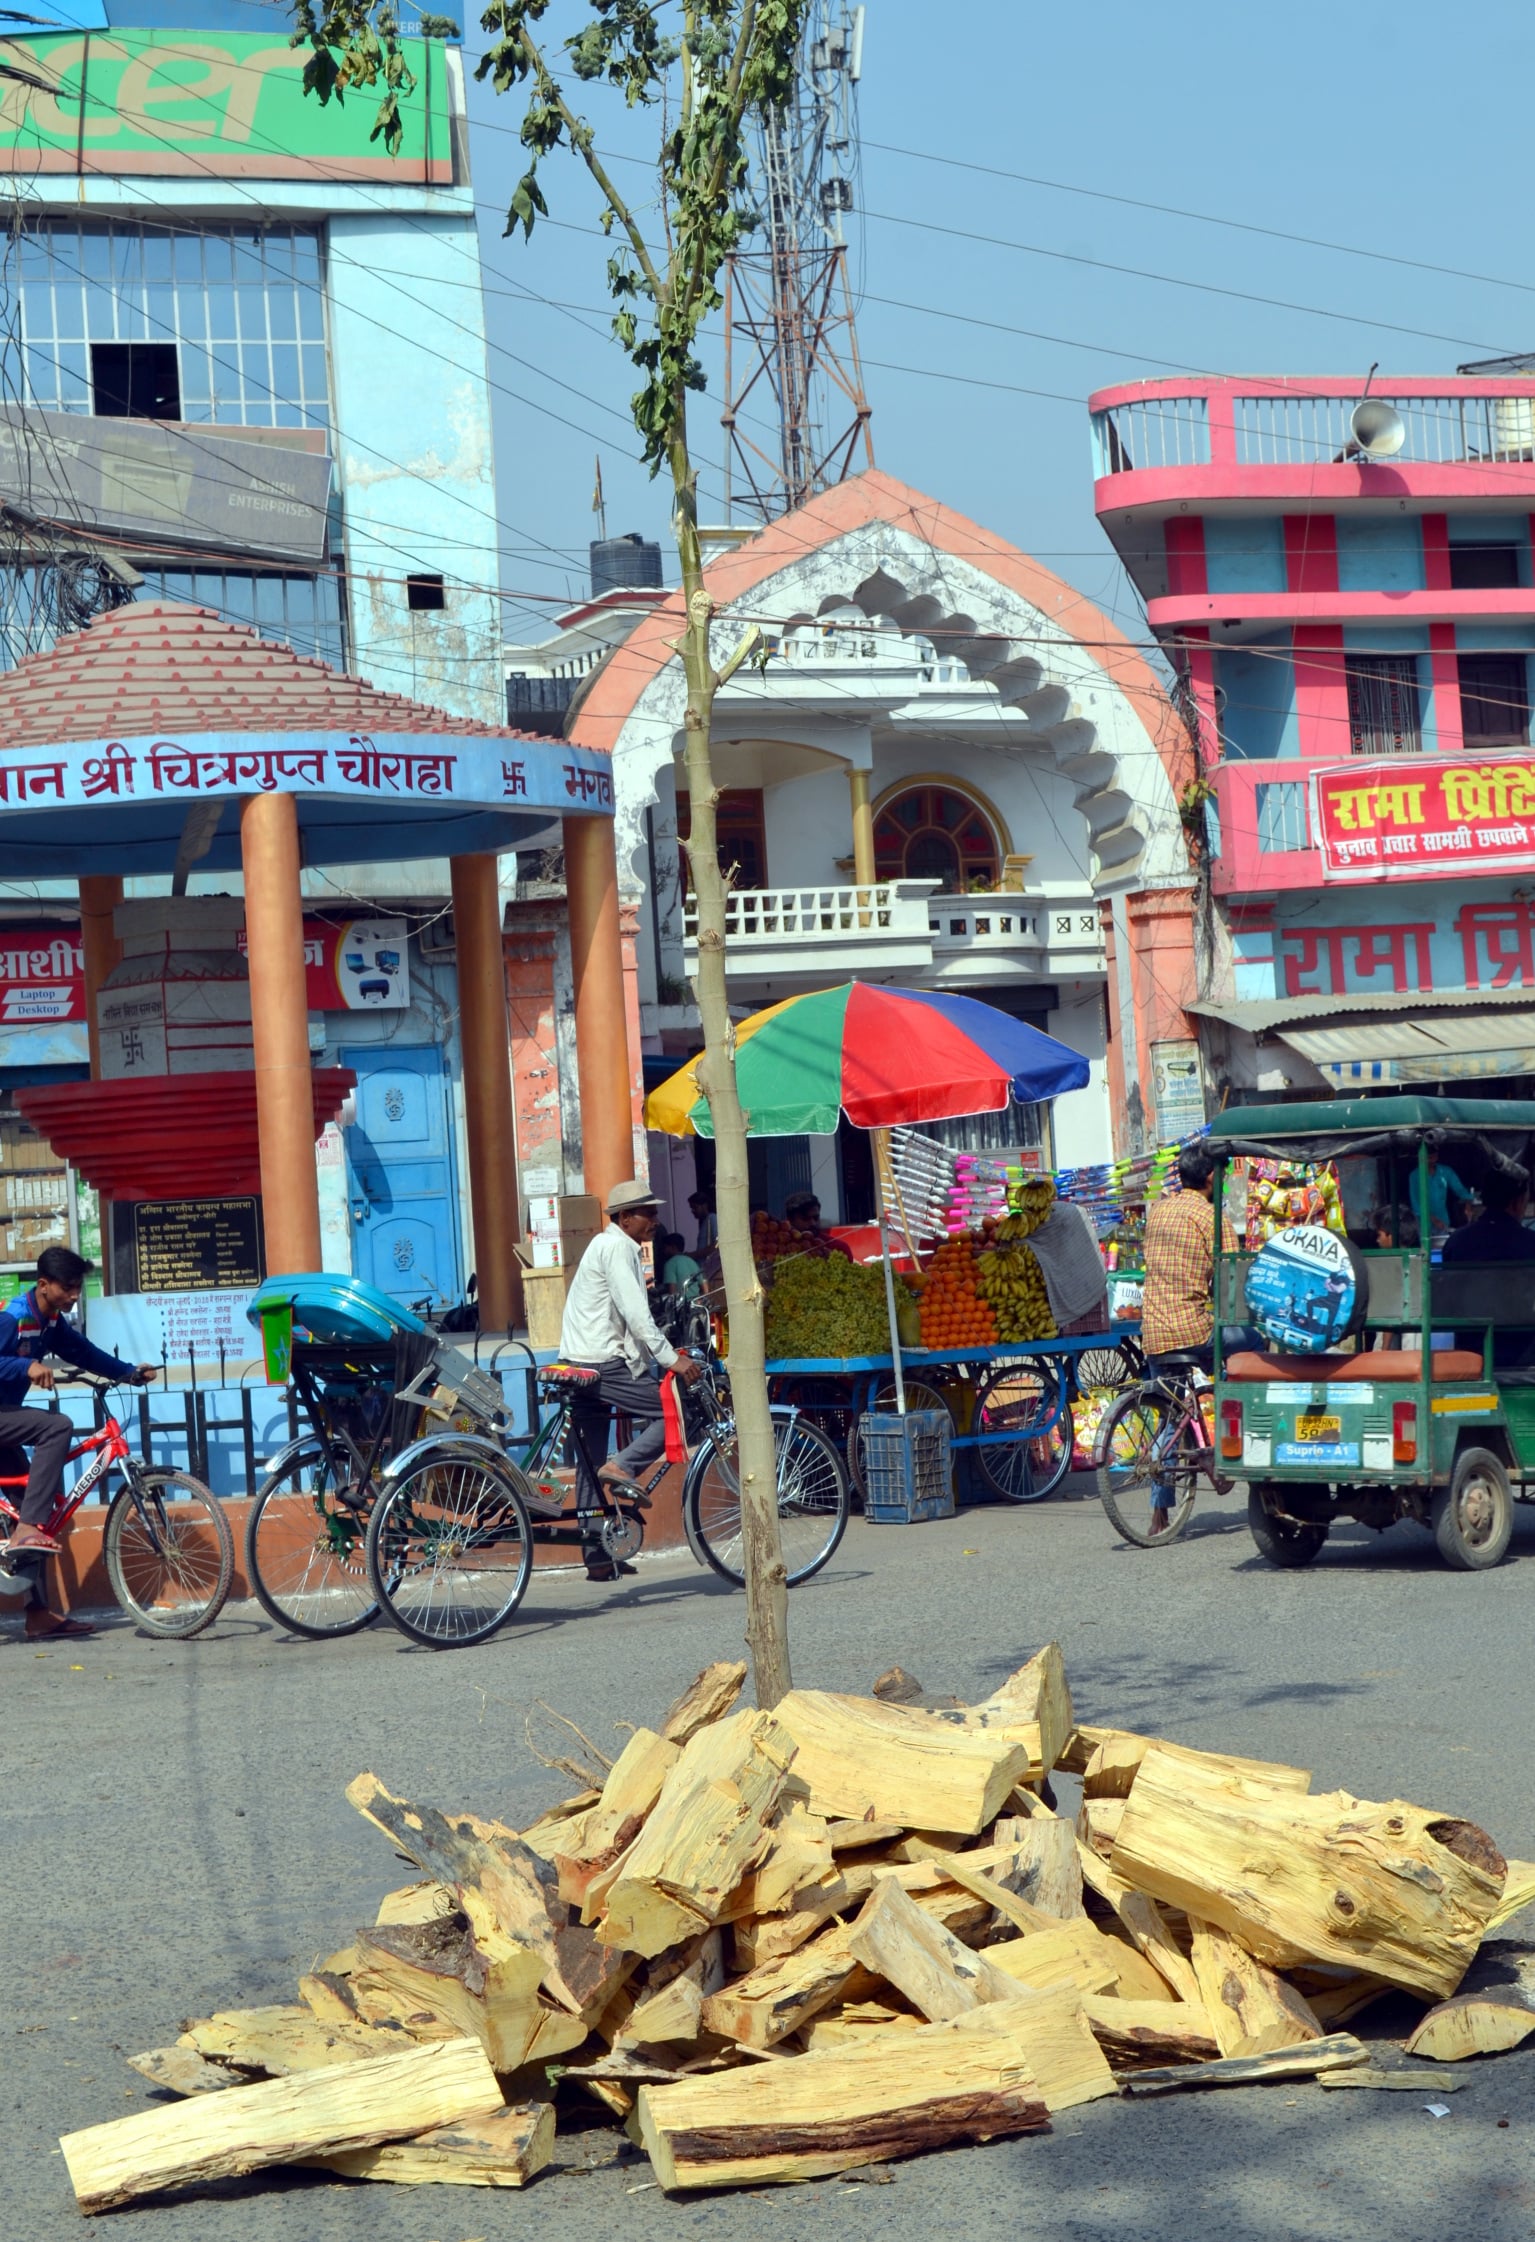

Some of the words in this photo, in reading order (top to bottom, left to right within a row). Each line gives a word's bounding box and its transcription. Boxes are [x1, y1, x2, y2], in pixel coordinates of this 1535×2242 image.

[250, 478, 296, 496] ASHISH
[228, 493, 313, 518] ENTERPRISES
[80, 742, 137, 798] श्री
[145, 741, 328, 791] चित्रगुप्त
[335, 736, 457, 795] चौराहा
[1328, 783, 1426, 830] रामा
[1333, 837, 1378, 863] चुनाव
[1421, 826, 1472, 851] सामग्री
[1475, 822, 1529, 847] छपवाने
[1282, 922, 1436, 998] रामा
[18, 1002, 60, 1015] Desktop
[20, 990, 56, 1002] Laptop
[1282, 1228, 1339, 1259] OKAYA
[73, 1463, 101, 1497] HERO
